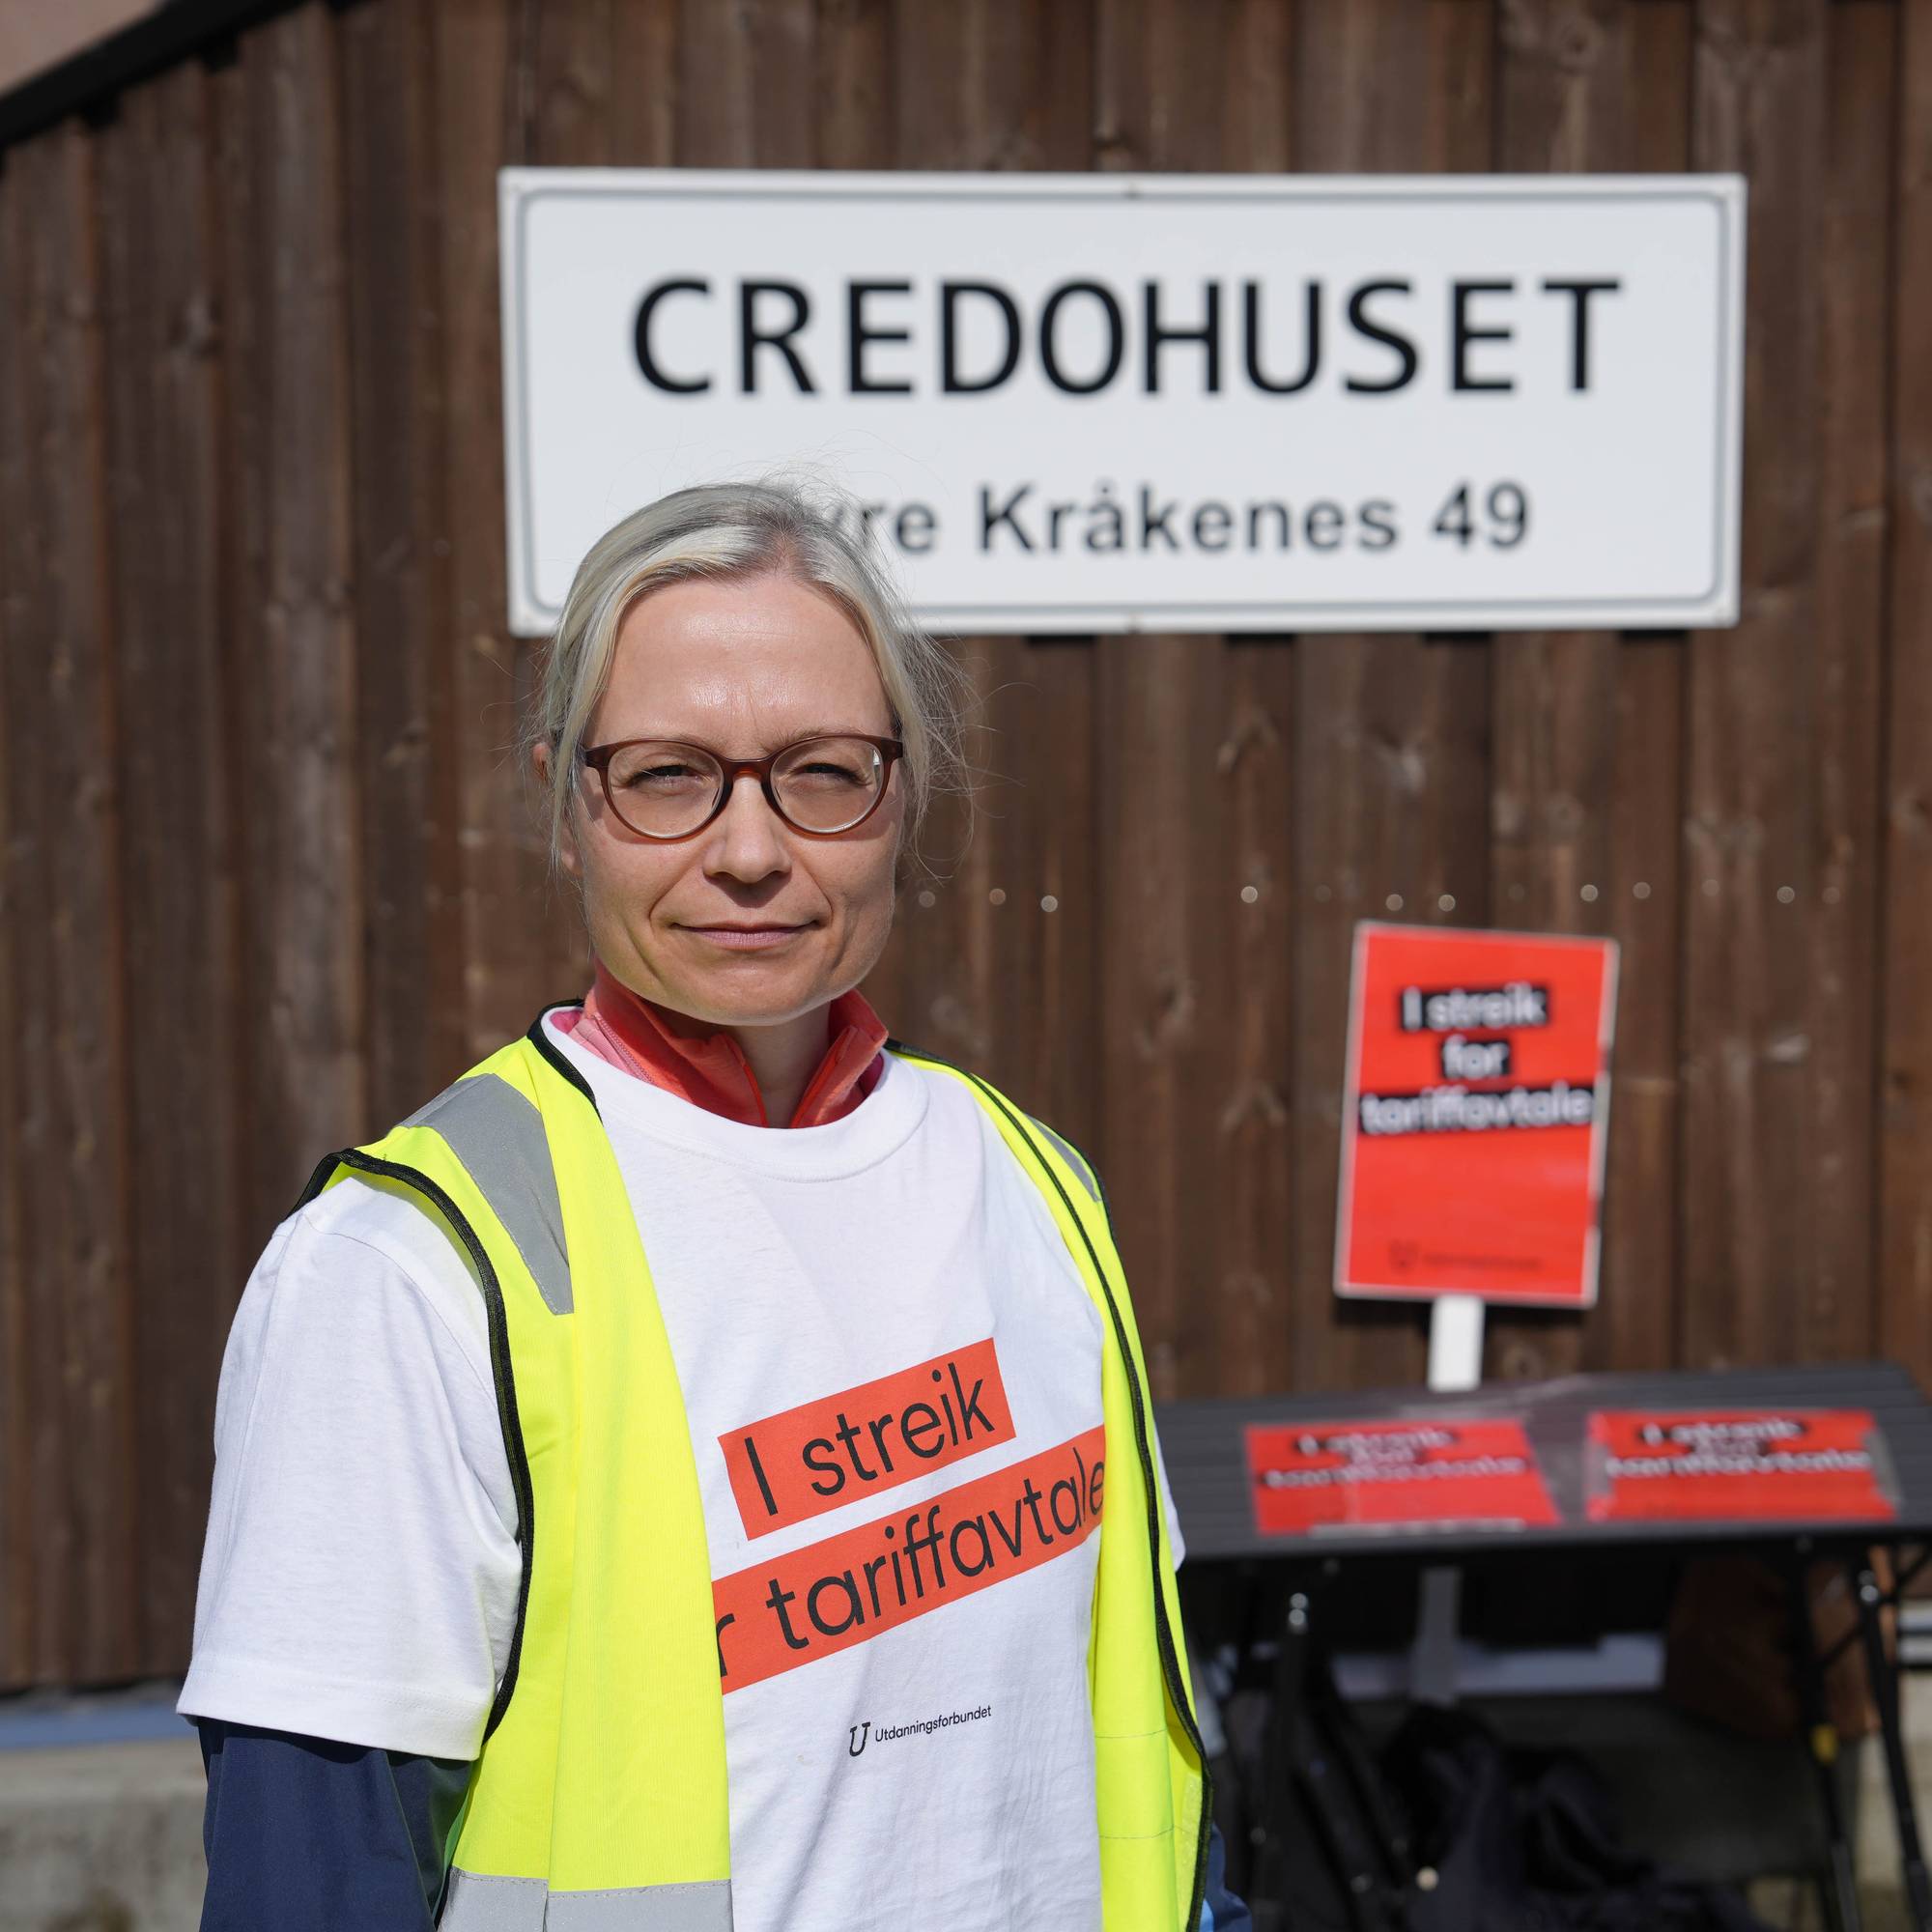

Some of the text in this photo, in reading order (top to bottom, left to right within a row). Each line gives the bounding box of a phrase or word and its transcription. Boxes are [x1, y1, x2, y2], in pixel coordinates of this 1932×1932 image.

[630, 274, 1623, 398] CREDOHUSET
[978, 482, 1399, 554] Kråkenes
[1433, 481, 1530, 551] 49
[1426, 980, 1548, 1031] streik
[1441, 1034, 1511, 1080] for
[1360, 1081, 1594, 1136] tariffavtale
[744, 1361, 996, 1517] I streik
[765, 1446, 1105, 1650] tariffavtale
[874, 1704, 992, 1743] Utdanningsforbundet
